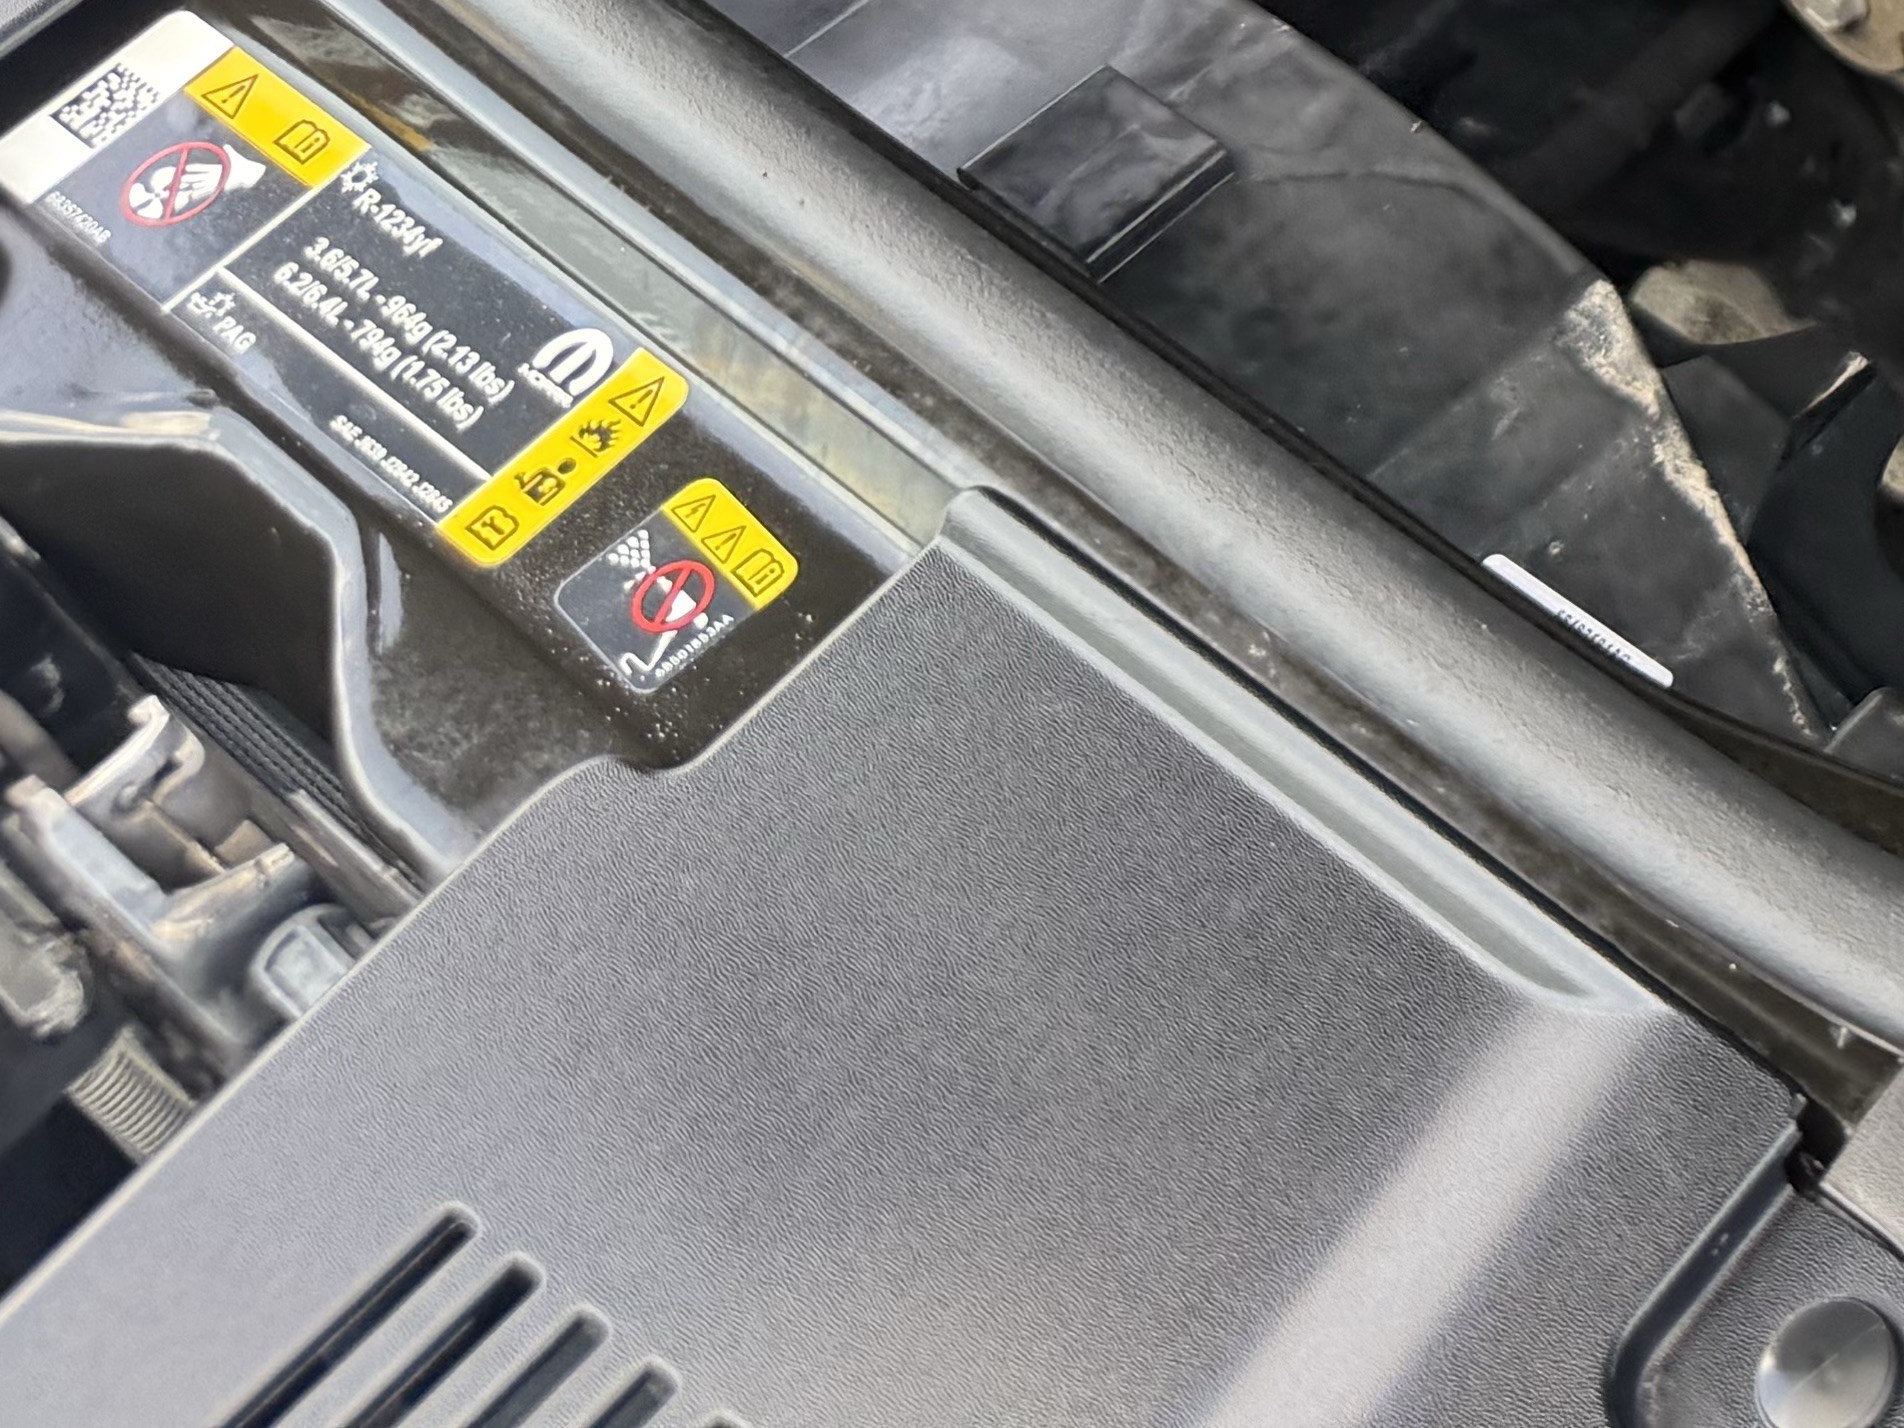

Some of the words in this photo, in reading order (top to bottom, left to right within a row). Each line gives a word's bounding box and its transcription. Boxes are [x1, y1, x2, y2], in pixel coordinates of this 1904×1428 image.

[350, 187, 444, 264] R-1234yf
[211, 314, 259, 354] PAG
[271, 259, 351, 326] 6.2/6.4L
[387, 351, 451, 402] (1.75
[435, 385, 486, 433] lbs)
[301, 233, 383, 302] 3.6/5.7L
[418, 325, 482, 379] (2.13
[466, 359, 517, 407] lbs)
[327, 413, 364, 443] SAE
